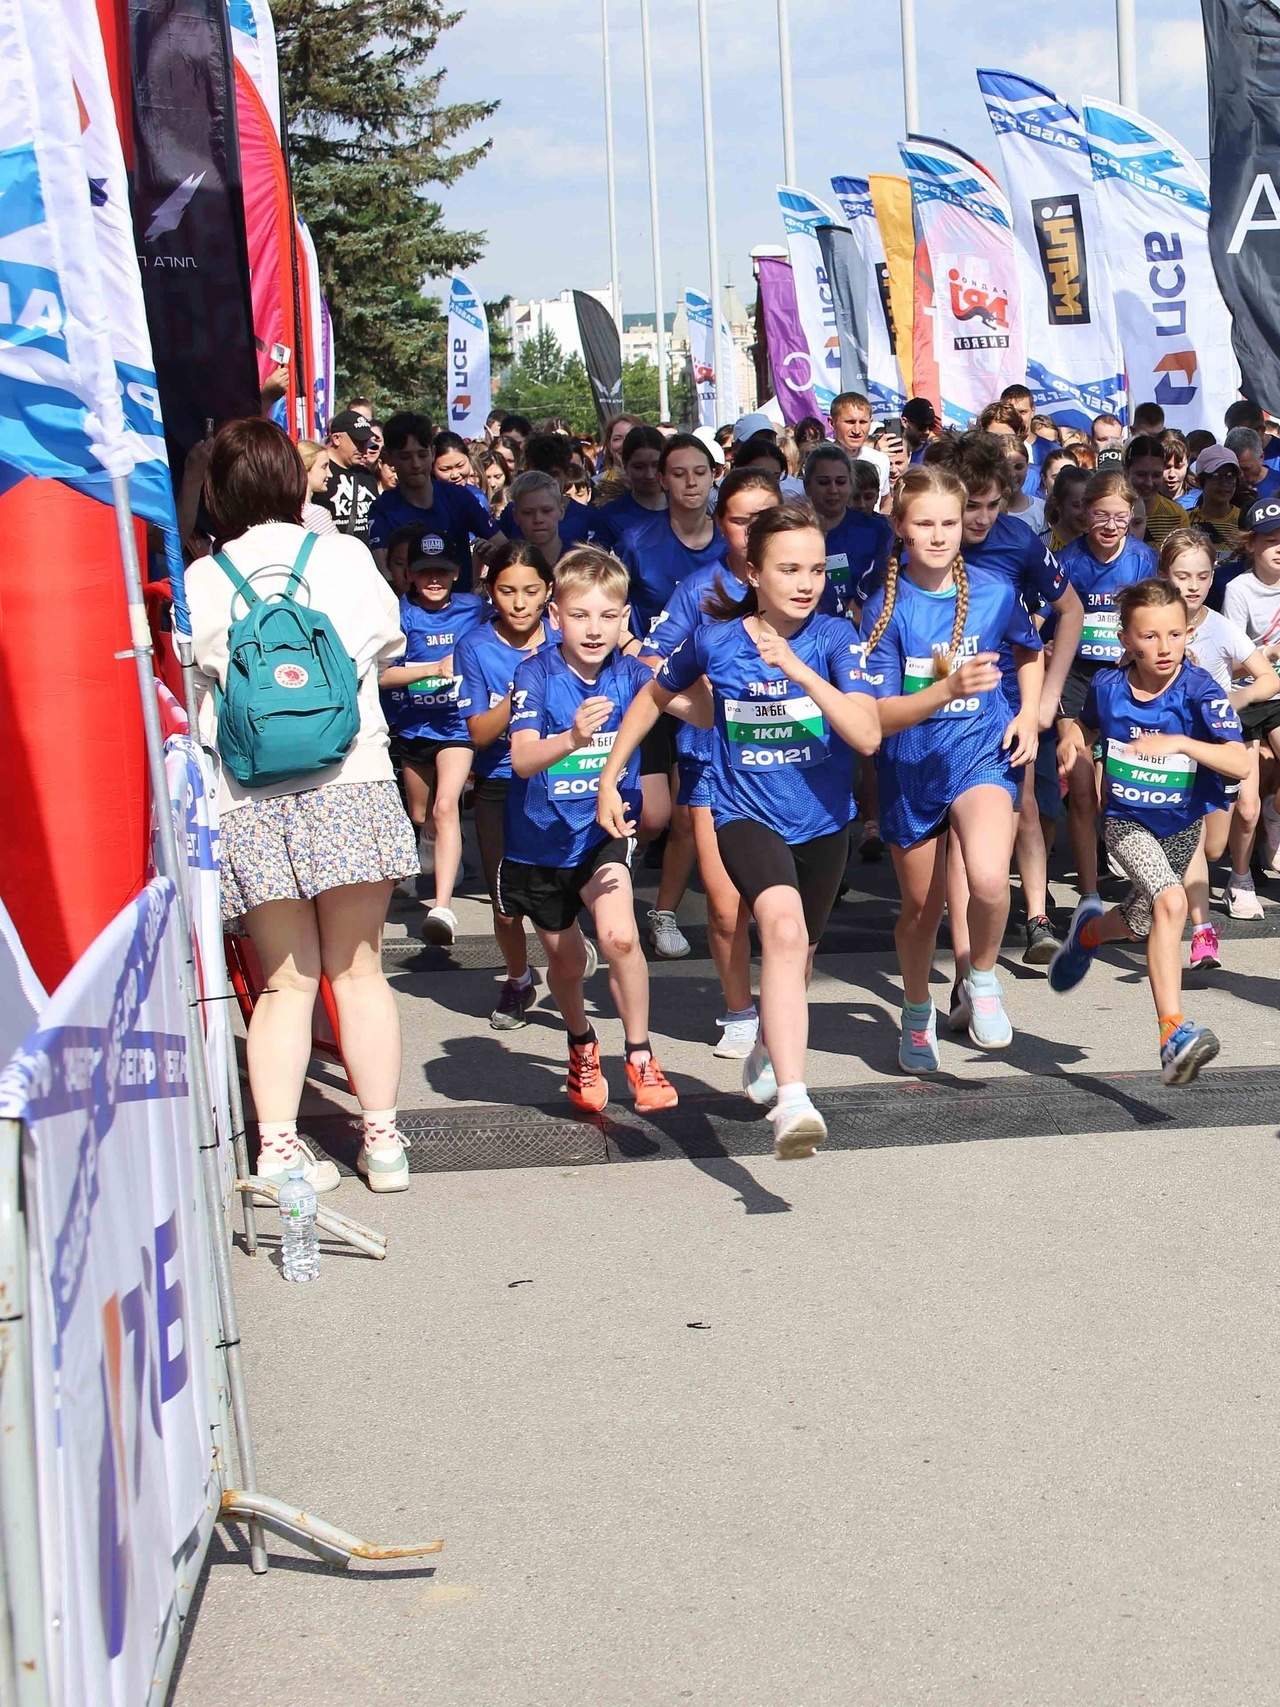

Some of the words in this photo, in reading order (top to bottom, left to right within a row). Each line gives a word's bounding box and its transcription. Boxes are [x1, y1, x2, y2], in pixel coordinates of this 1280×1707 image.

[422, 539, 444, 549] MIAMI
[943, 697, 980, 713] 109
[1211, 699, 1230, 718] 7
[741, 746, 811, 766] 20121
[553, 778, 601, 795] 200
[1111, 782, 1183, 804] 20104
